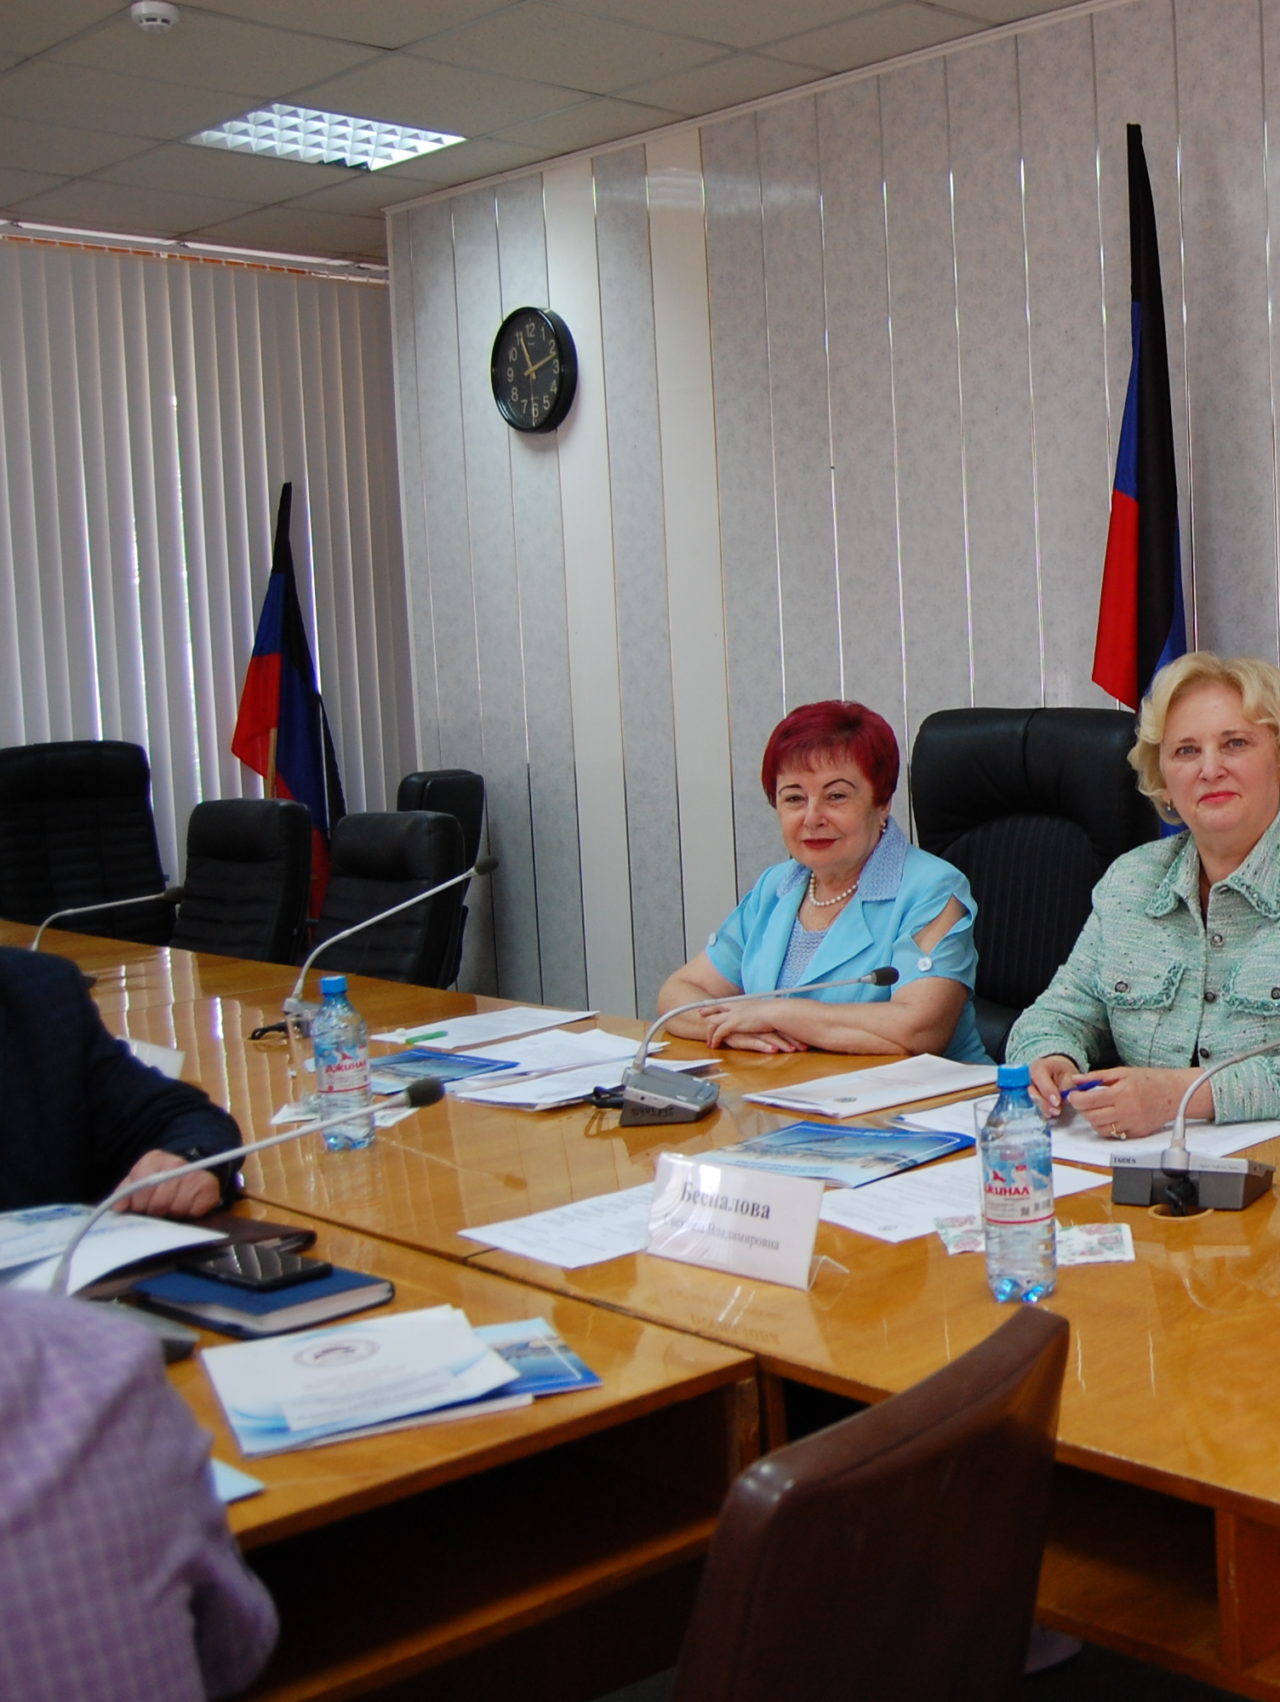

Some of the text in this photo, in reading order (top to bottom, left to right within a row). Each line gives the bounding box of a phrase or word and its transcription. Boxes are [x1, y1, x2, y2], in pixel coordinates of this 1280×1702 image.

[526, 322, 535, 337] 12
[540, 327, 546, 341] 1
[508, 347, 518, 361] 10
[549, 339, 556, 354] 2
[552, 359, 559, 374] 3
[507, 367, 514, 382] 9
[550, 379, 557, 394] 4
[511, 387, 519, 402] 8
[521, 399, 528, 414] 7
[543, 395, 550, 410] 5
